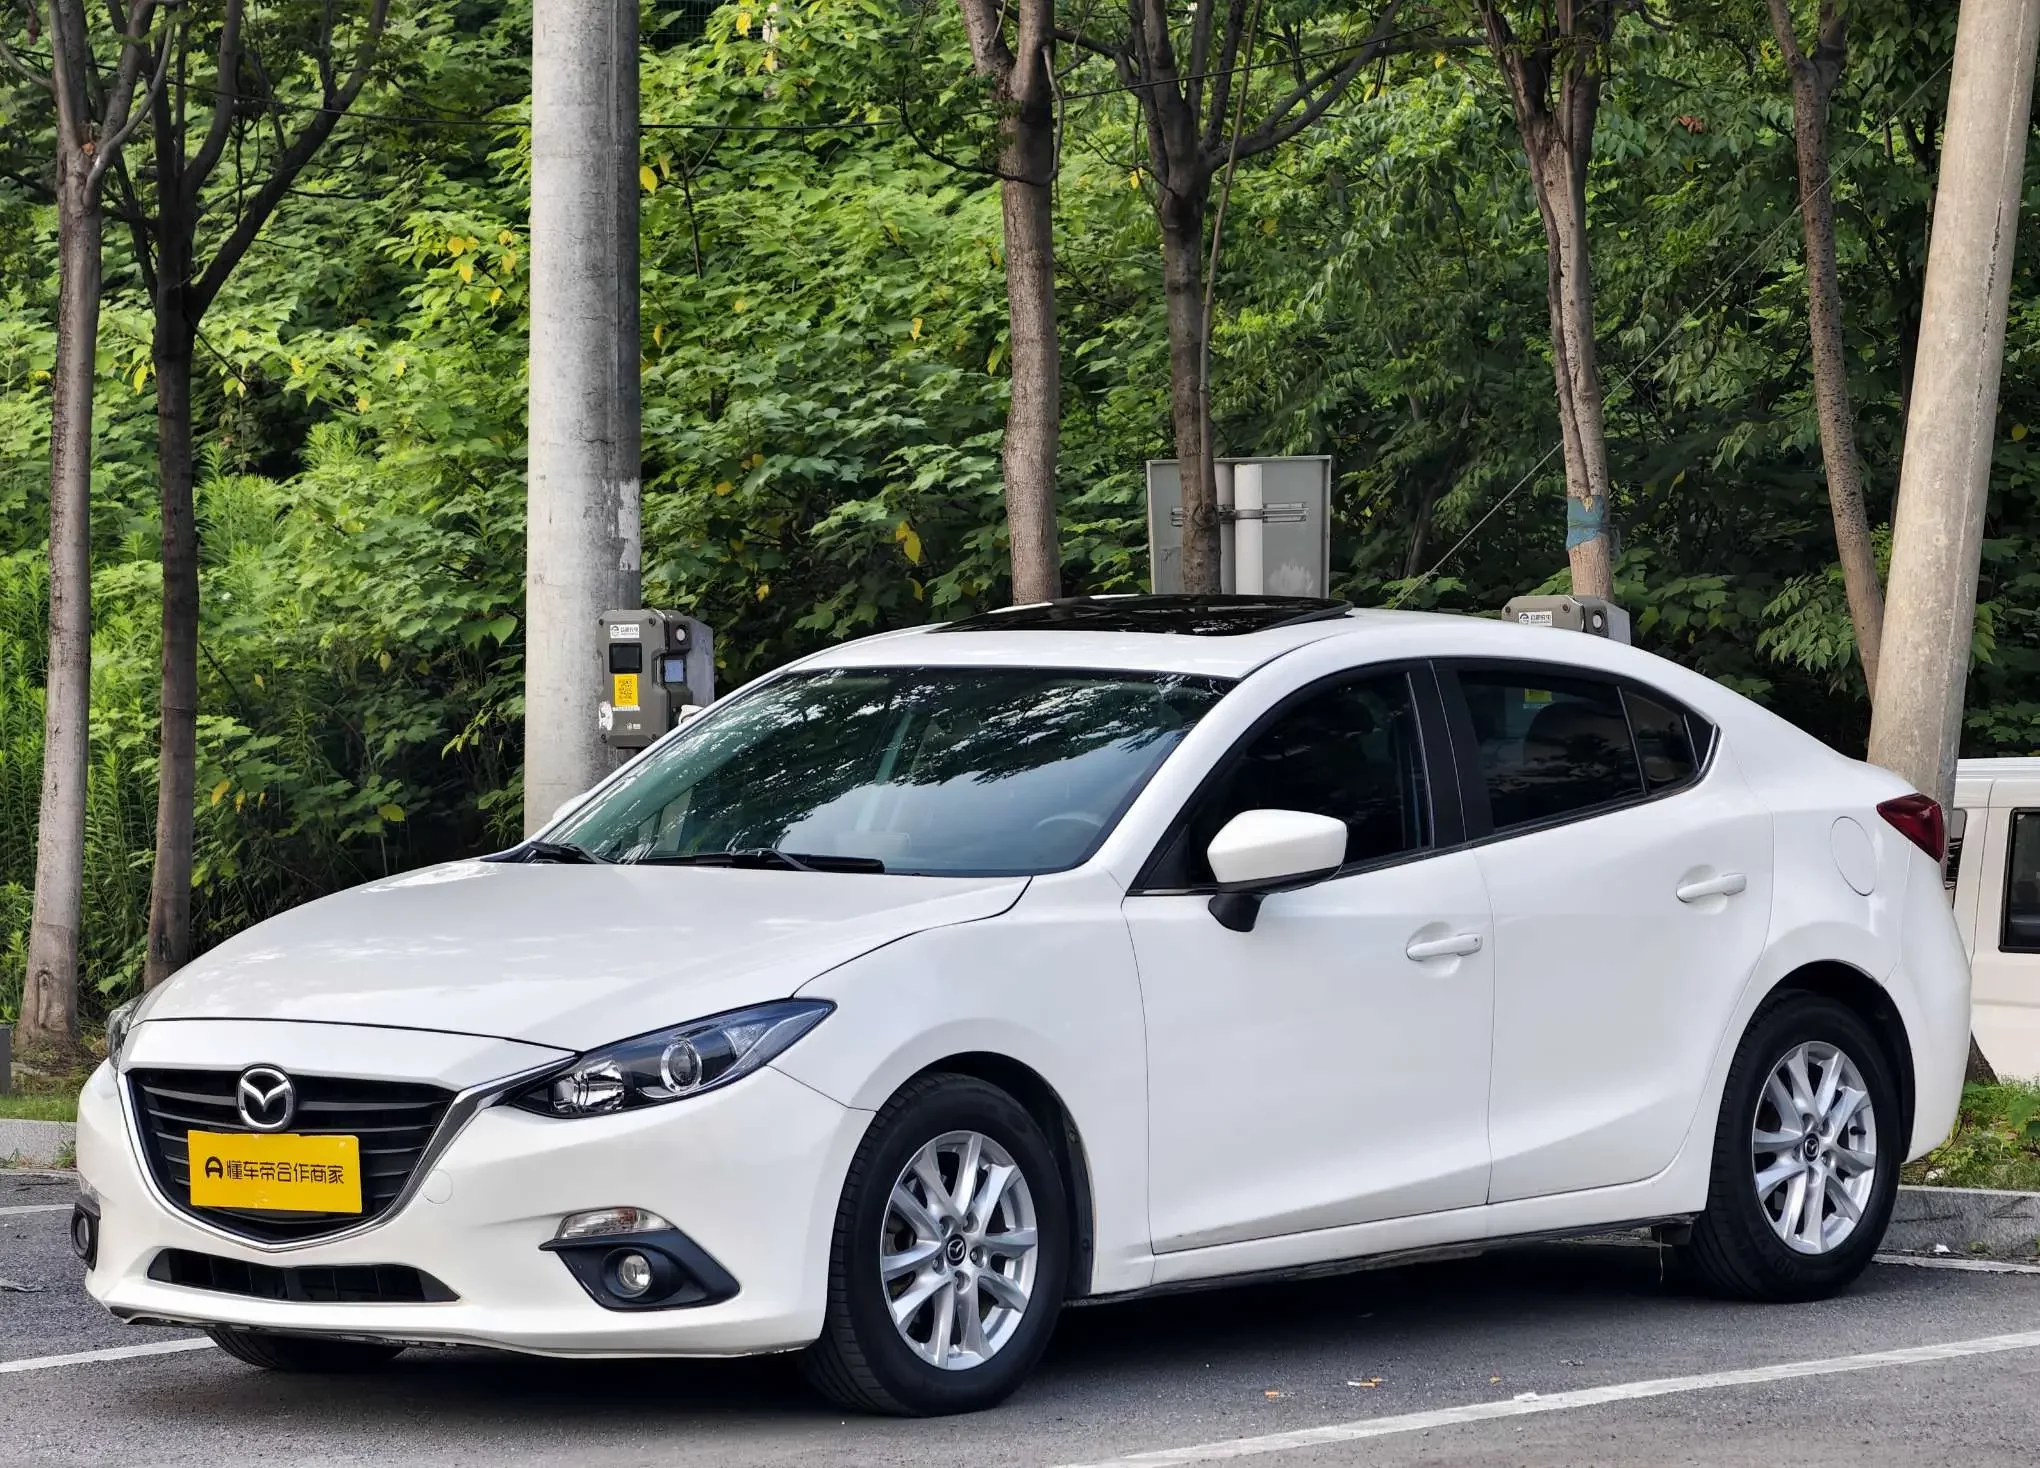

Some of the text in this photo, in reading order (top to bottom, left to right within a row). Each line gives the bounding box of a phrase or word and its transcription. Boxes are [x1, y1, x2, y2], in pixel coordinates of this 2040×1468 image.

[226, 1160, 345, 1185] 懂车帝合作商家
